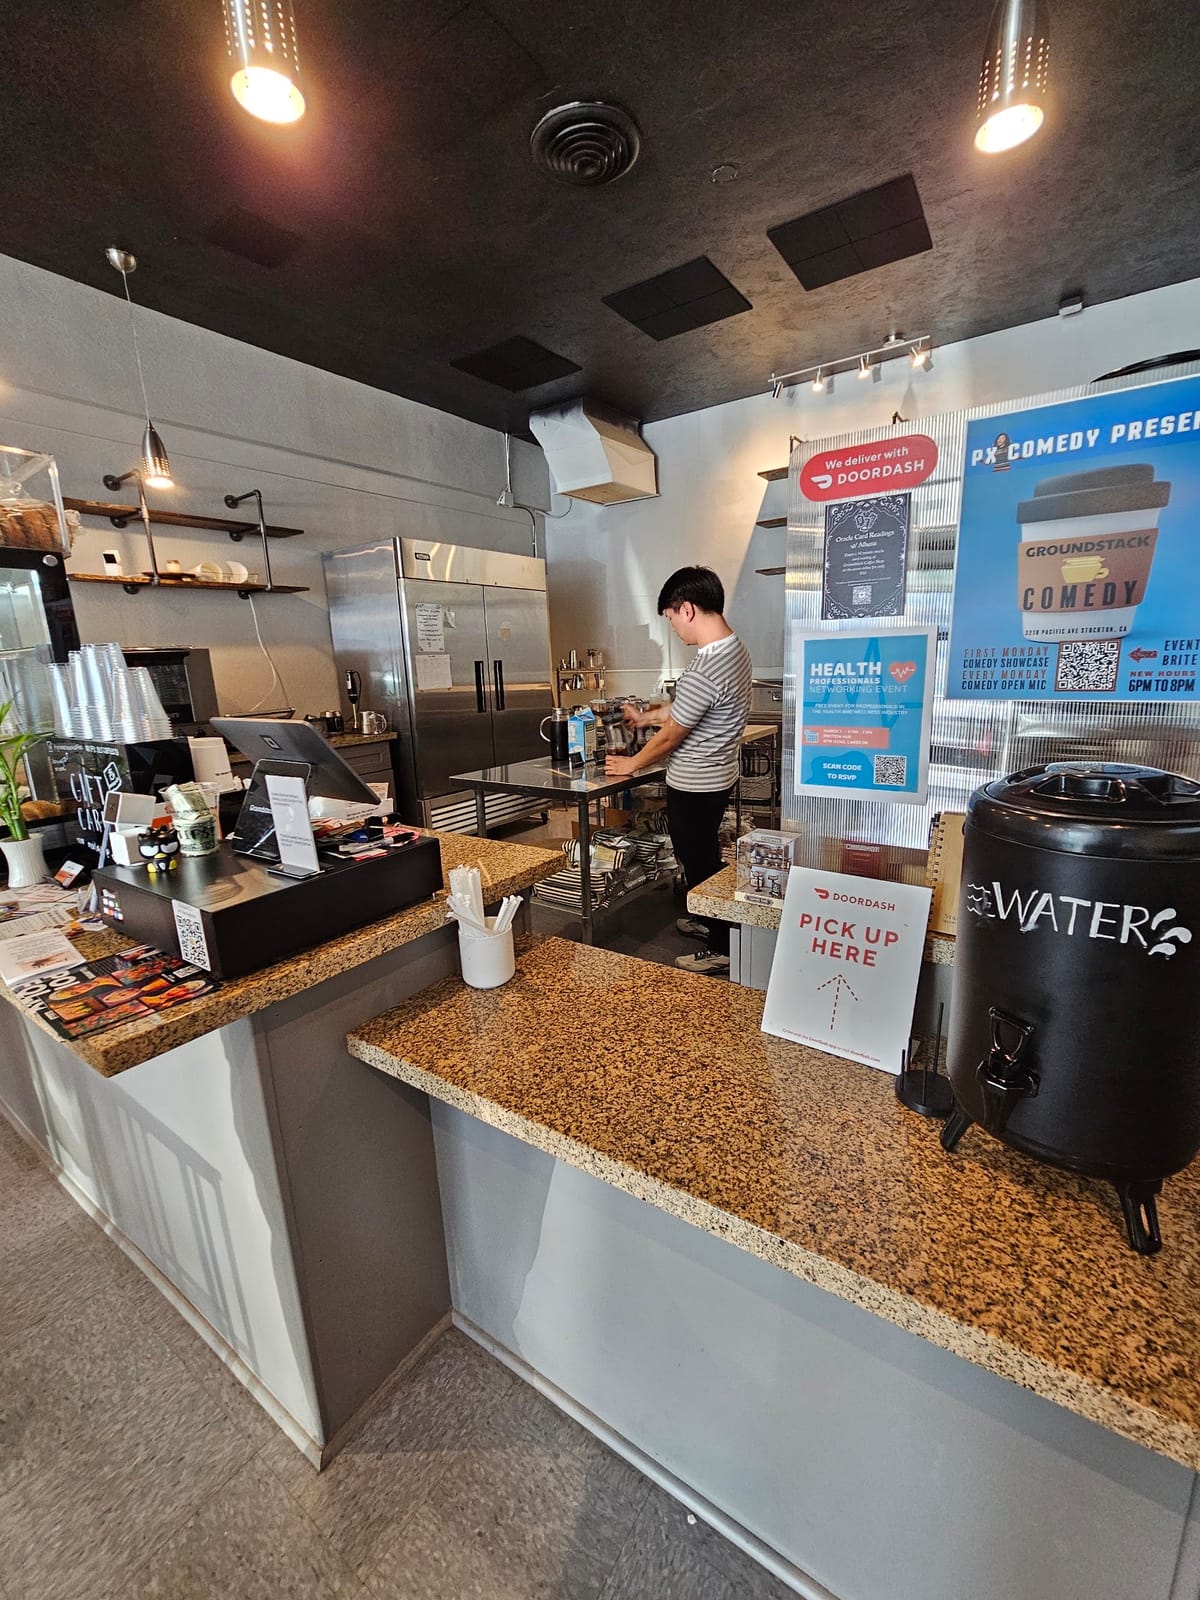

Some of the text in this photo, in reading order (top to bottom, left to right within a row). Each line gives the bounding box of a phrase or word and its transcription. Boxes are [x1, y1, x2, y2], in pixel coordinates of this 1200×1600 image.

[971, 446, 997, 467] PX
[1008, 428, 1101, 461] COMEDY
[825, 447, 909, 470] We deliver with
[838, 459, 925, 485] DOORDASH
[1026, 536, 1151, 557] GROUNDSTACK
[1023, 581, 1138, 610] COMEDY
[964, 647, 1049, 657] FIRST MONDAY
[1164, 639, 1200, 651] EVENT
[963, 657, 1049, 668] COMEDY SHOWCASE
[1162, 654, 1198, 666] BRITE
[810, 661, 882, 676] HEALTH
[962, 669, 1046, 680] EVERY MONDAY
[809, 677, 881, 685] PROFESSIONALS
[961, 680, 1047, 690] COMEDY OPEN MIC
[1128, 679, 1196, 692] 6PM TO 8PM
[809, 685, 908, 694] NETWORKING EVENT
[822, 762, 841, 770] SCAN
[77, 807, 105, 833] CAR
[833, 893, 895, 911] DOORDASH
[992, 882, 1150, 948] WATER
[800, 913, 899, 947] PICK UP
[812, 937, 877, 967] HERE
